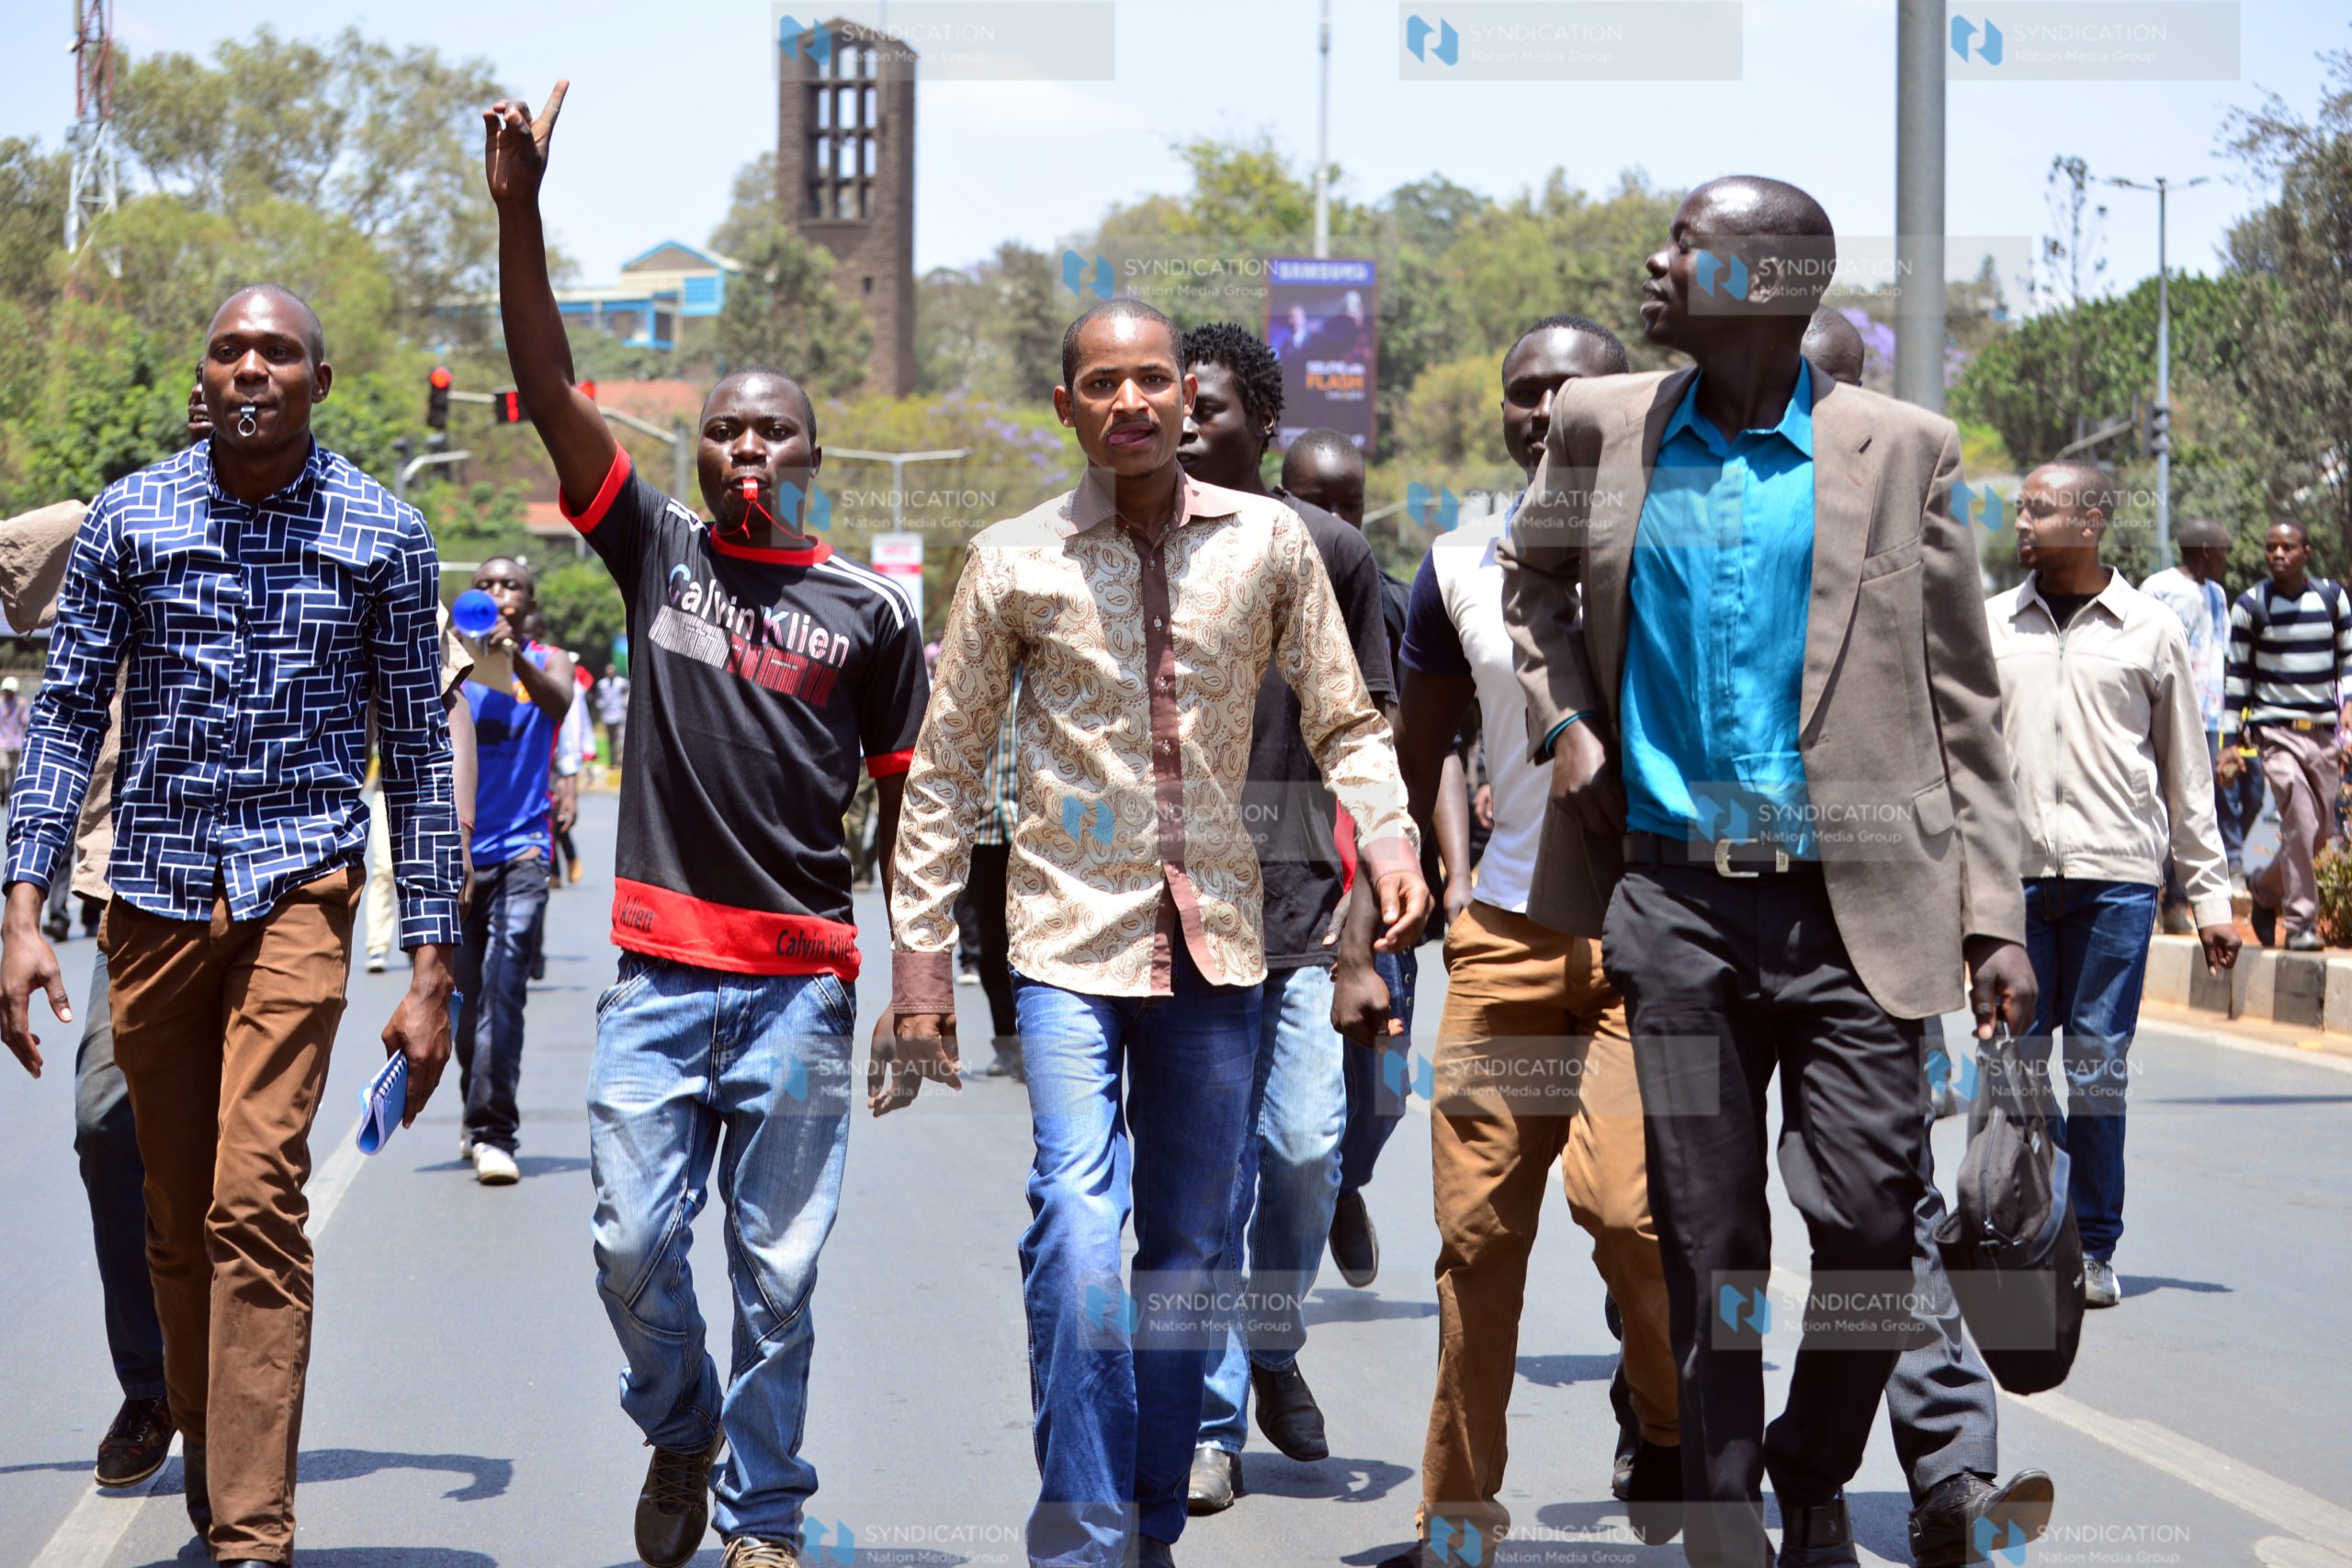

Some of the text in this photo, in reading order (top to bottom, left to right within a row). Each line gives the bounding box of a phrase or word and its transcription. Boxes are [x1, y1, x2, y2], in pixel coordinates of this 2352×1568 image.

[668, 563, 850, 669] Calvin Klien
[776, 929, 826, 957] Calvin
